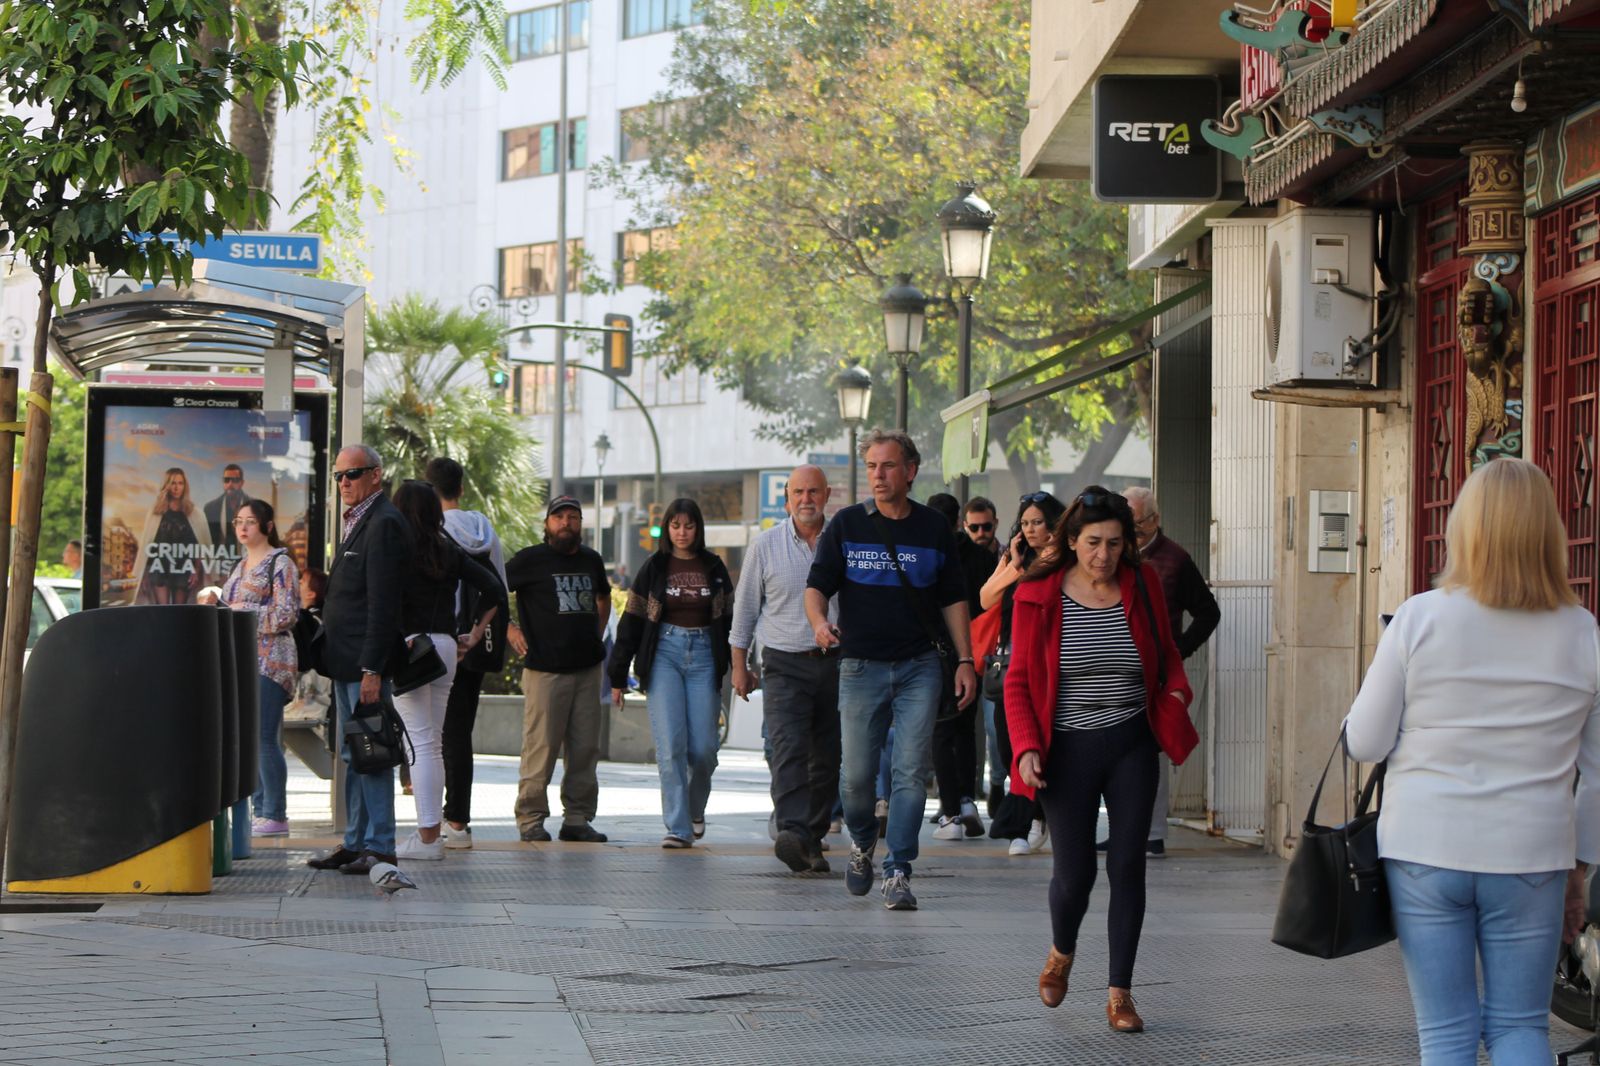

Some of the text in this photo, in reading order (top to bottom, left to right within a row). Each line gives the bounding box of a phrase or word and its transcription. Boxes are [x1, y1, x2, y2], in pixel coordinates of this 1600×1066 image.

[1108, 122, 1190, 151] RETA
[1167, 142, 1190, 155] bet
[229, 243, 313, 262] SEVILLA
[185, 398, 239, 408] Clear Channel
[149, 558, 236, 575] A LA VIS
